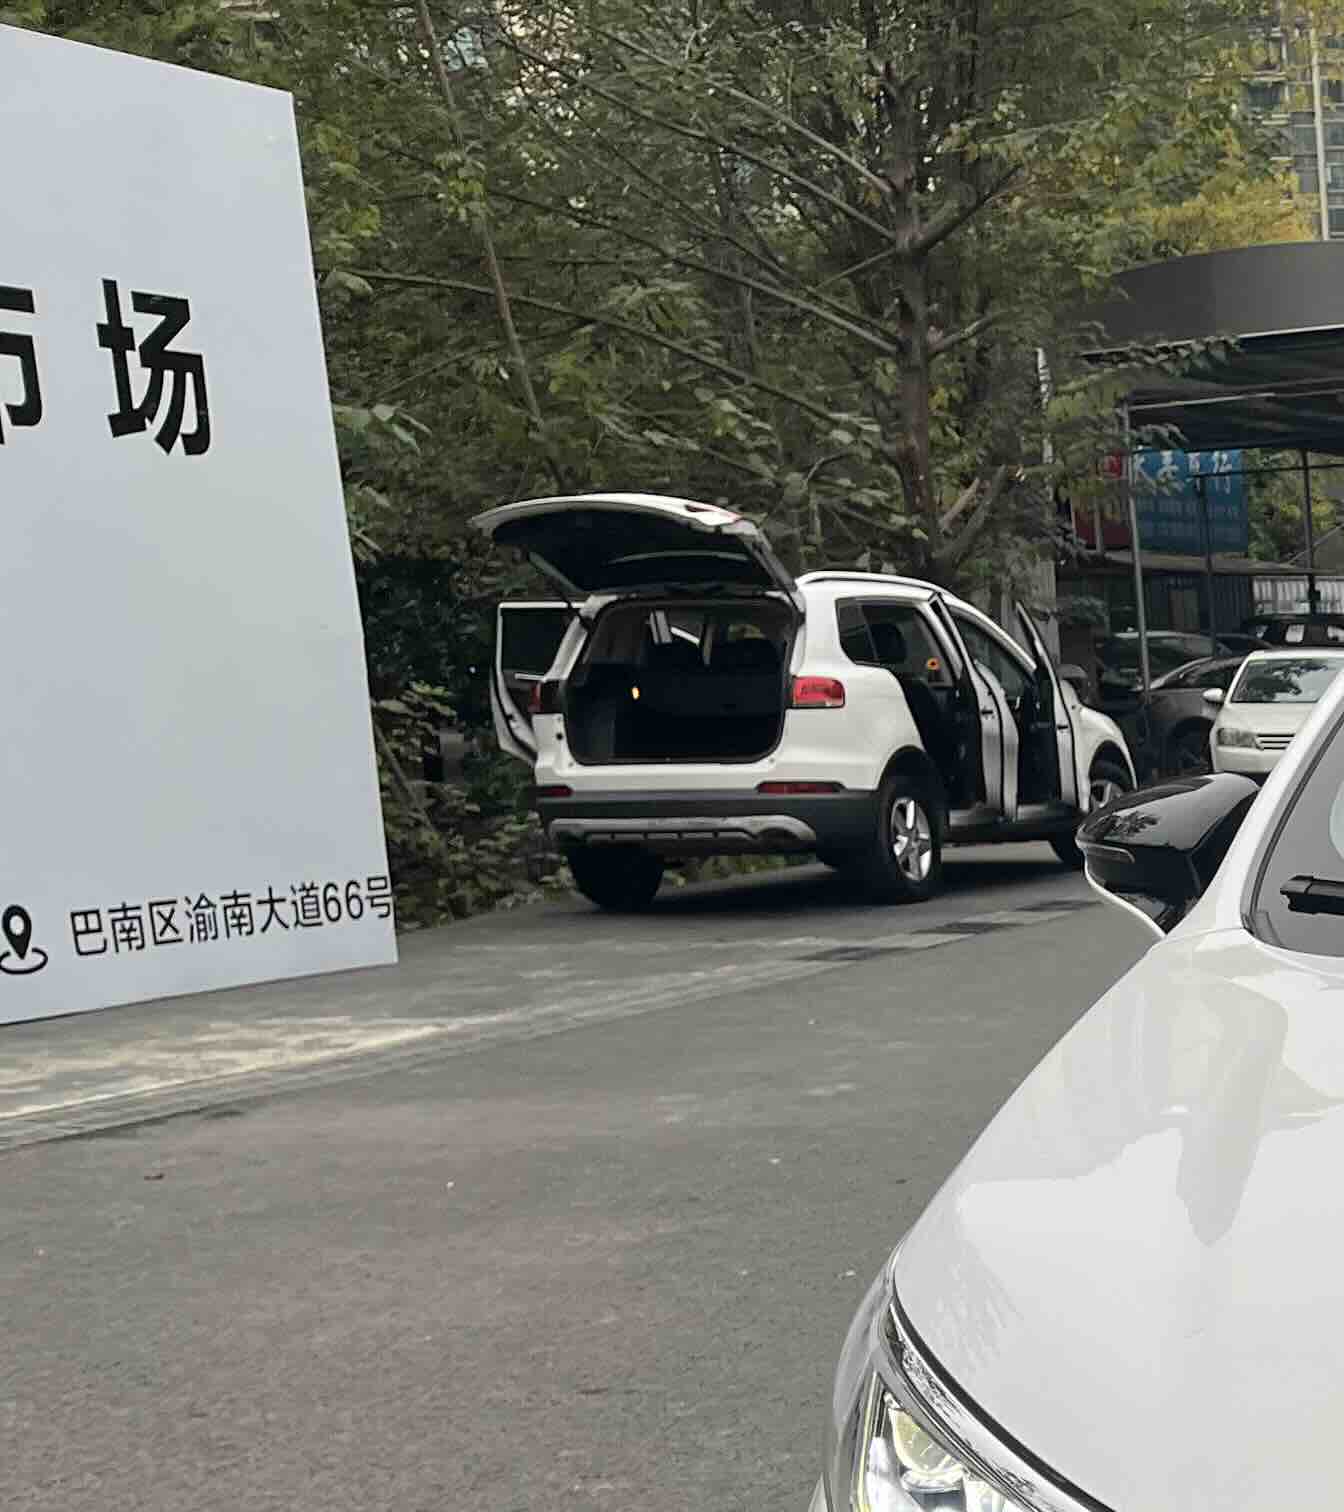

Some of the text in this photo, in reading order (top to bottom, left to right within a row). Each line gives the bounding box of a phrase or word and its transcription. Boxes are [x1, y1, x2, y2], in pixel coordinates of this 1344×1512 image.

[70, 875, 394, 957] 巴南区渝南大道66号
